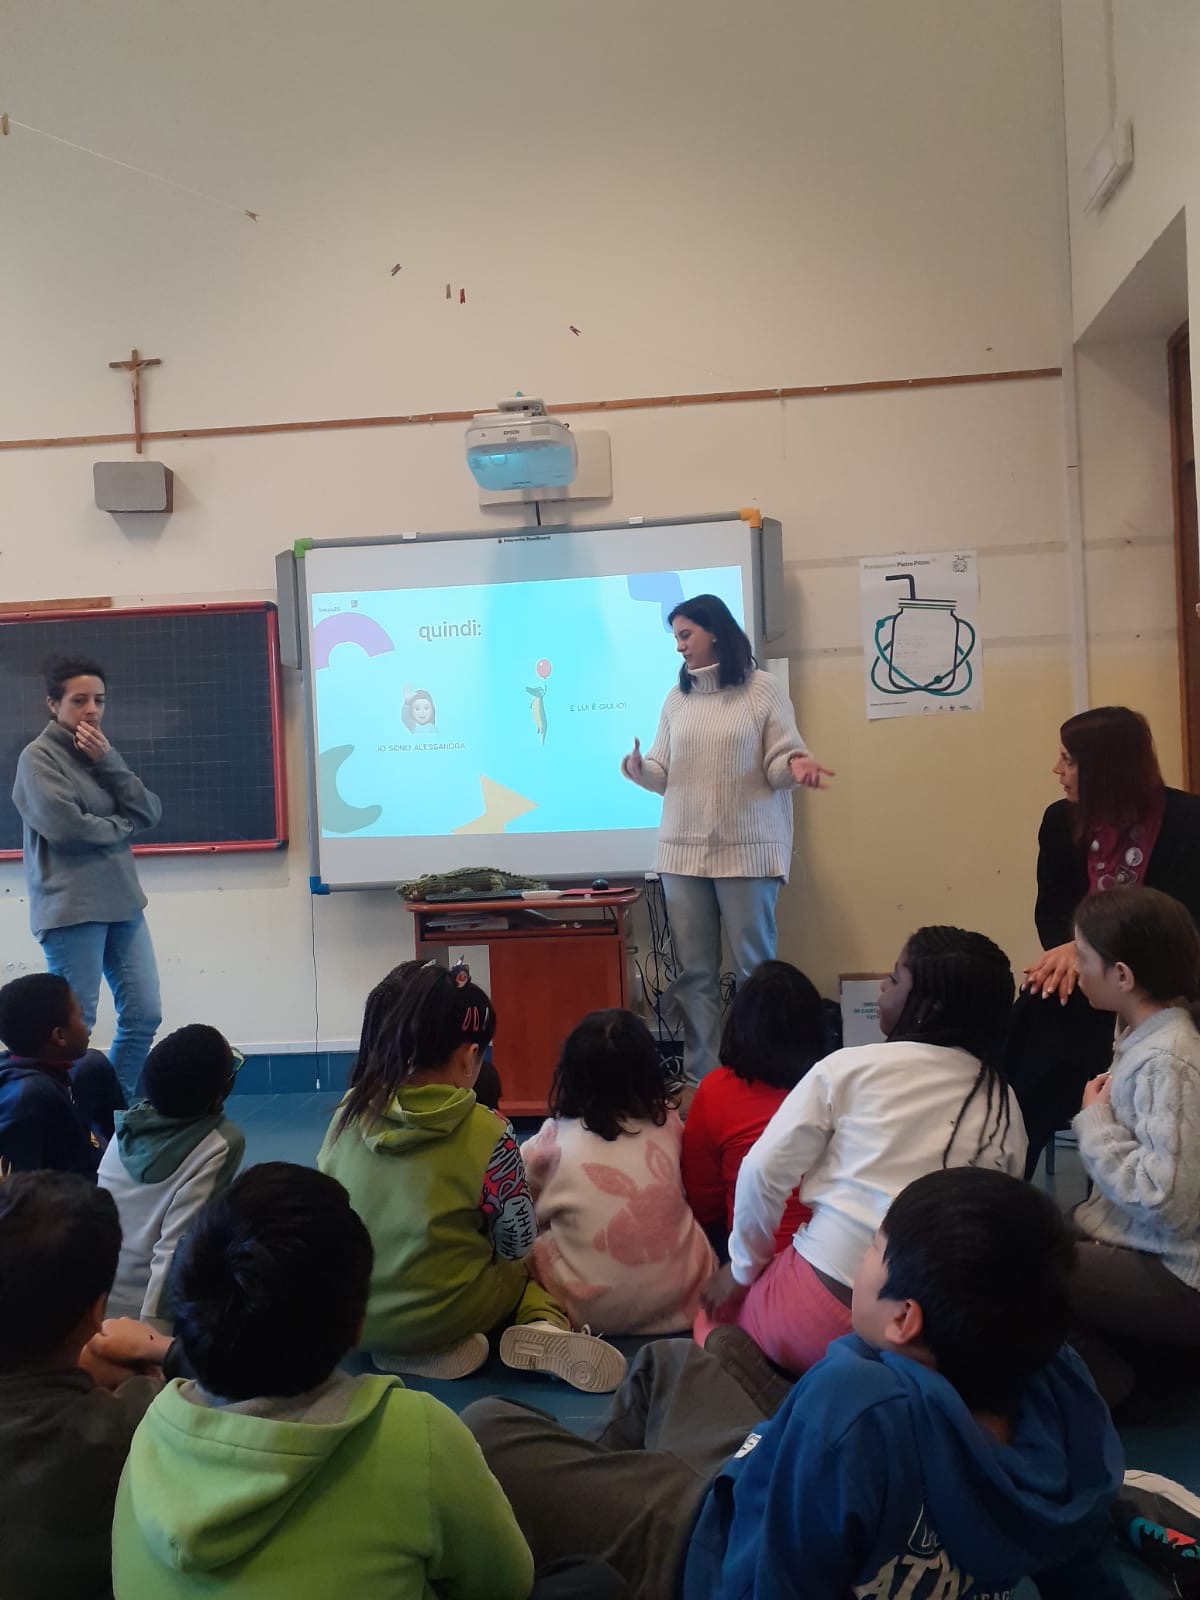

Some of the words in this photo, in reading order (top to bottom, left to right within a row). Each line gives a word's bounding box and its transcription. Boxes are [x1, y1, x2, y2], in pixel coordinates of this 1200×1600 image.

[419, 619, 482, 641] quindi:
[388, 744, 412, 752] SONO
[414, 742, 465, 751] ALESSANDRA
